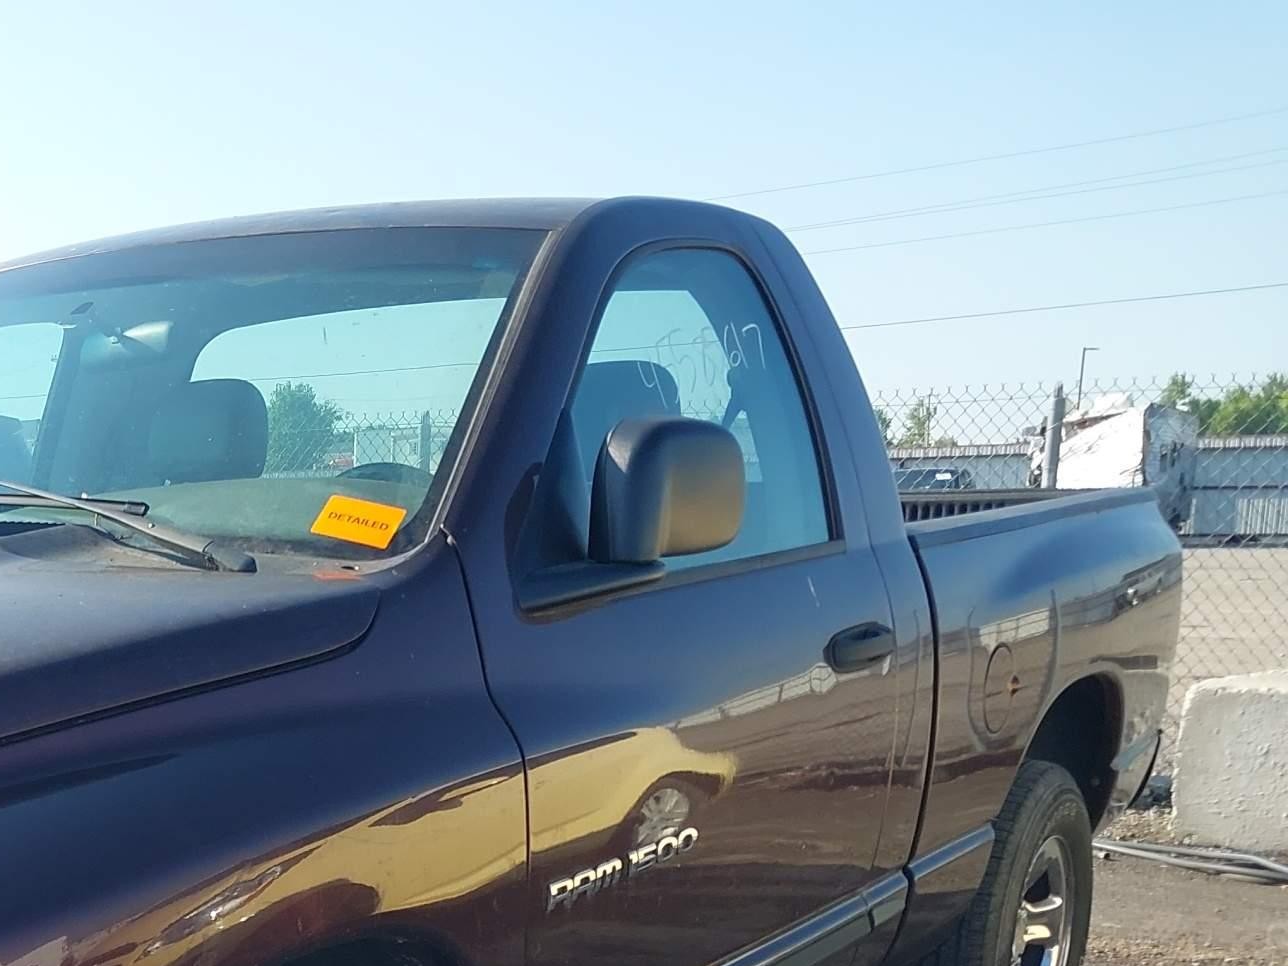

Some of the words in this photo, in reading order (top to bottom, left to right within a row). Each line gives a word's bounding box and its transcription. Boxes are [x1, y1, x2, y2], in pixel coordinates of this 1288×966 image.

[327, 511, 390, 531] DETAILED
[545, 856, 623, 913] RAM
[626, 827, 699, 876] 1500
